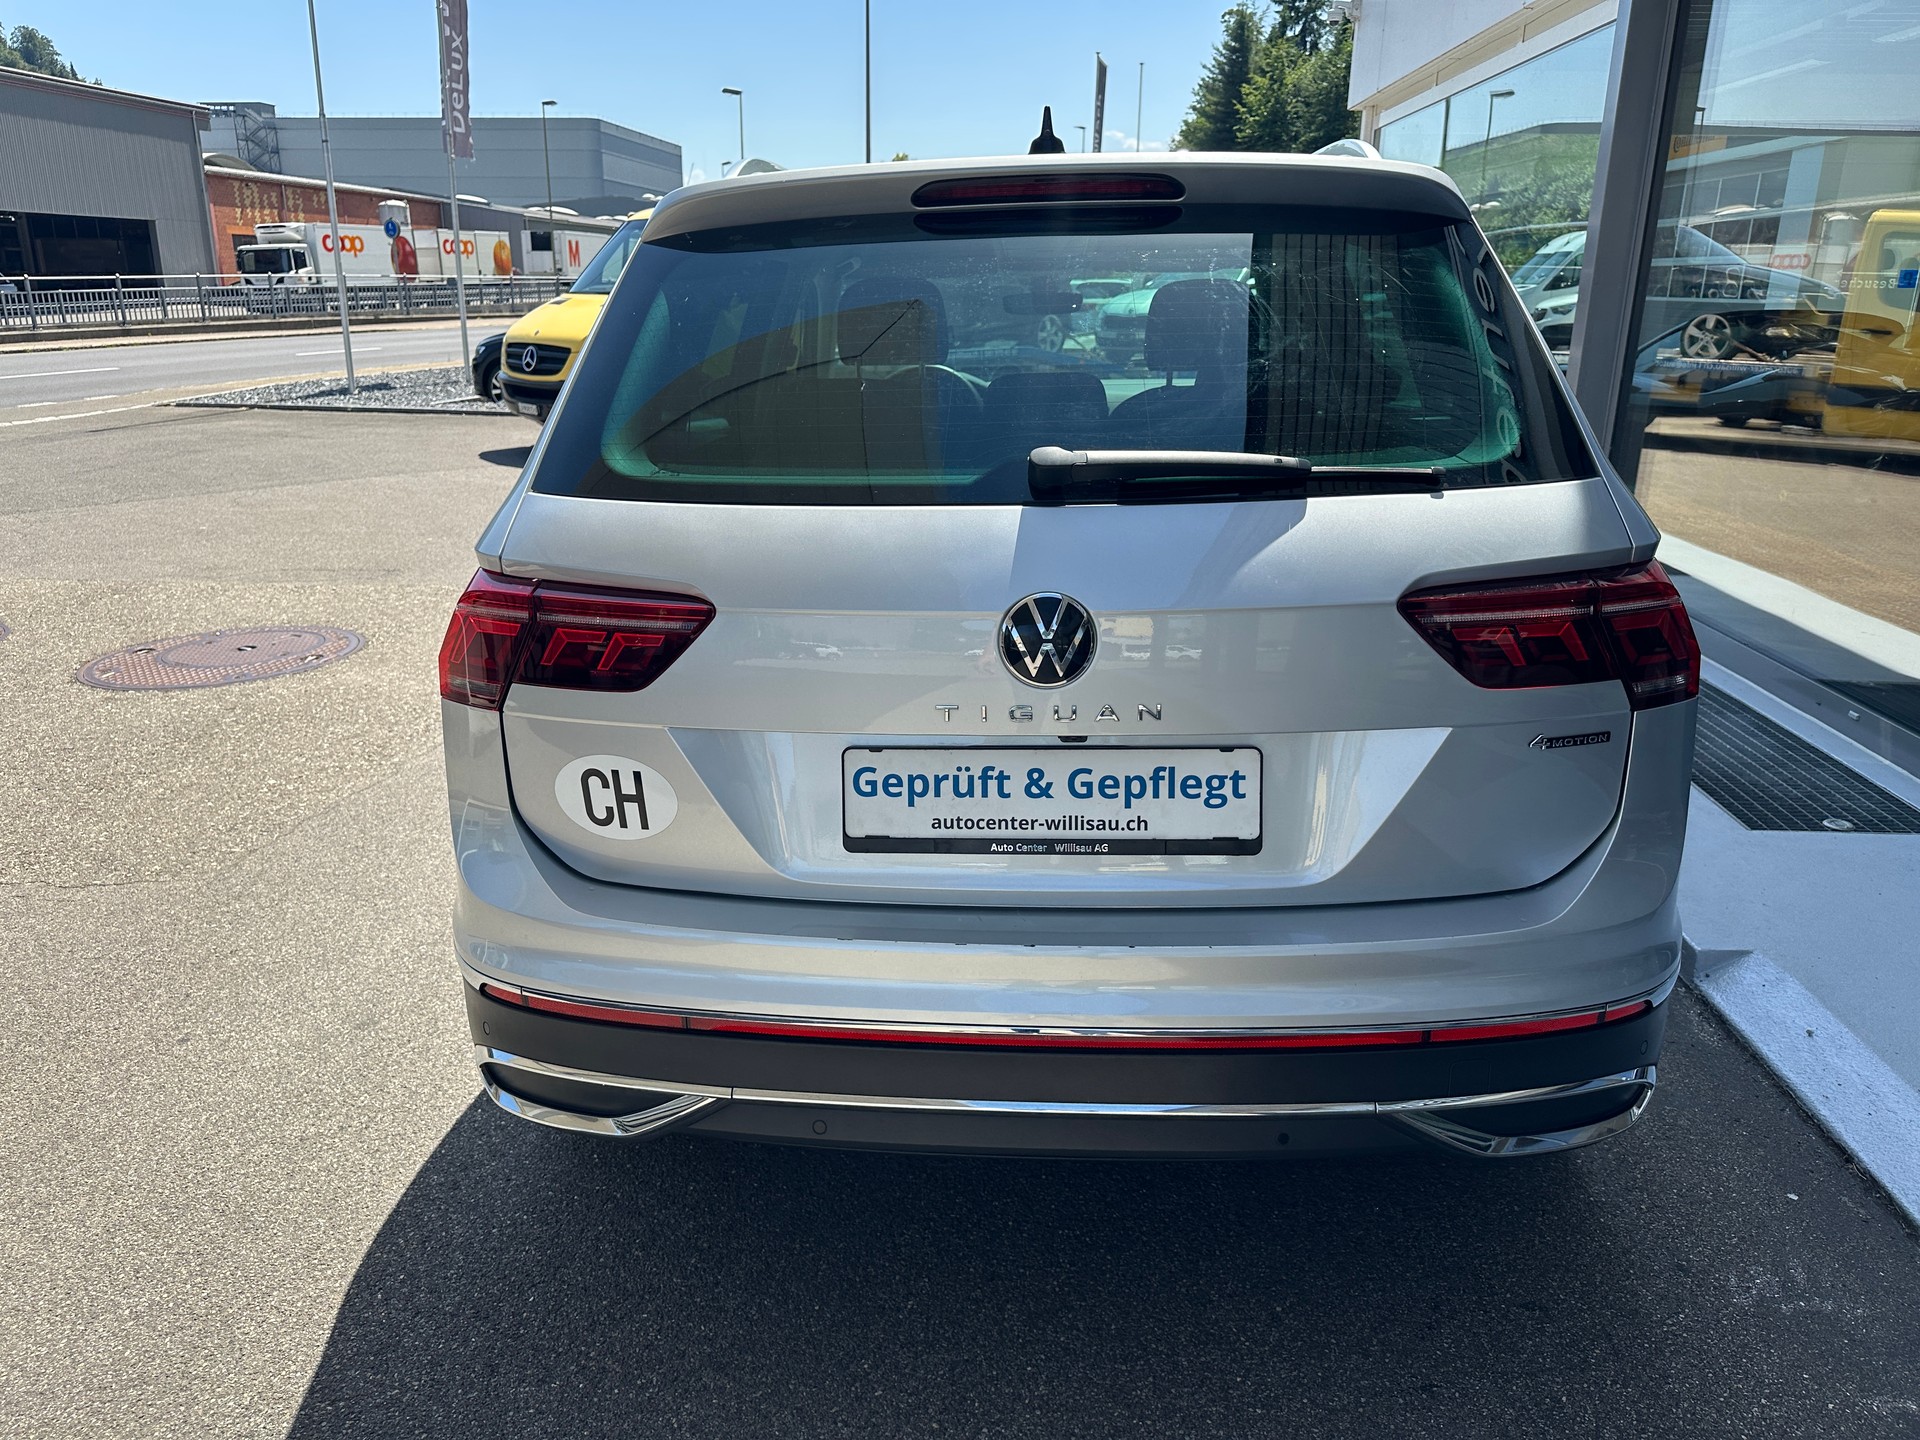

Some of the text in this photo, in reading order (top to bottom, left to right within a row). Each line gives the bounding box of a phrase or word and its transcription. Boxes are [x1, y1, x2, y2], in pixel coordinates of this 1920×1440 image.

[568, 239, 581, 268] M
[935, 703, 1163, 723] TIGUAN
[1528, 733, 1609, 750] 4MOTION
[852, 765, 1247, 809] Geprüft & Gepflegt
[580, 768, 650, 830] CH
[931, 815, 1149, 831] autocenter-willisau.ch
[990, 843, 1109, 853] Auto Center Willisau AG
